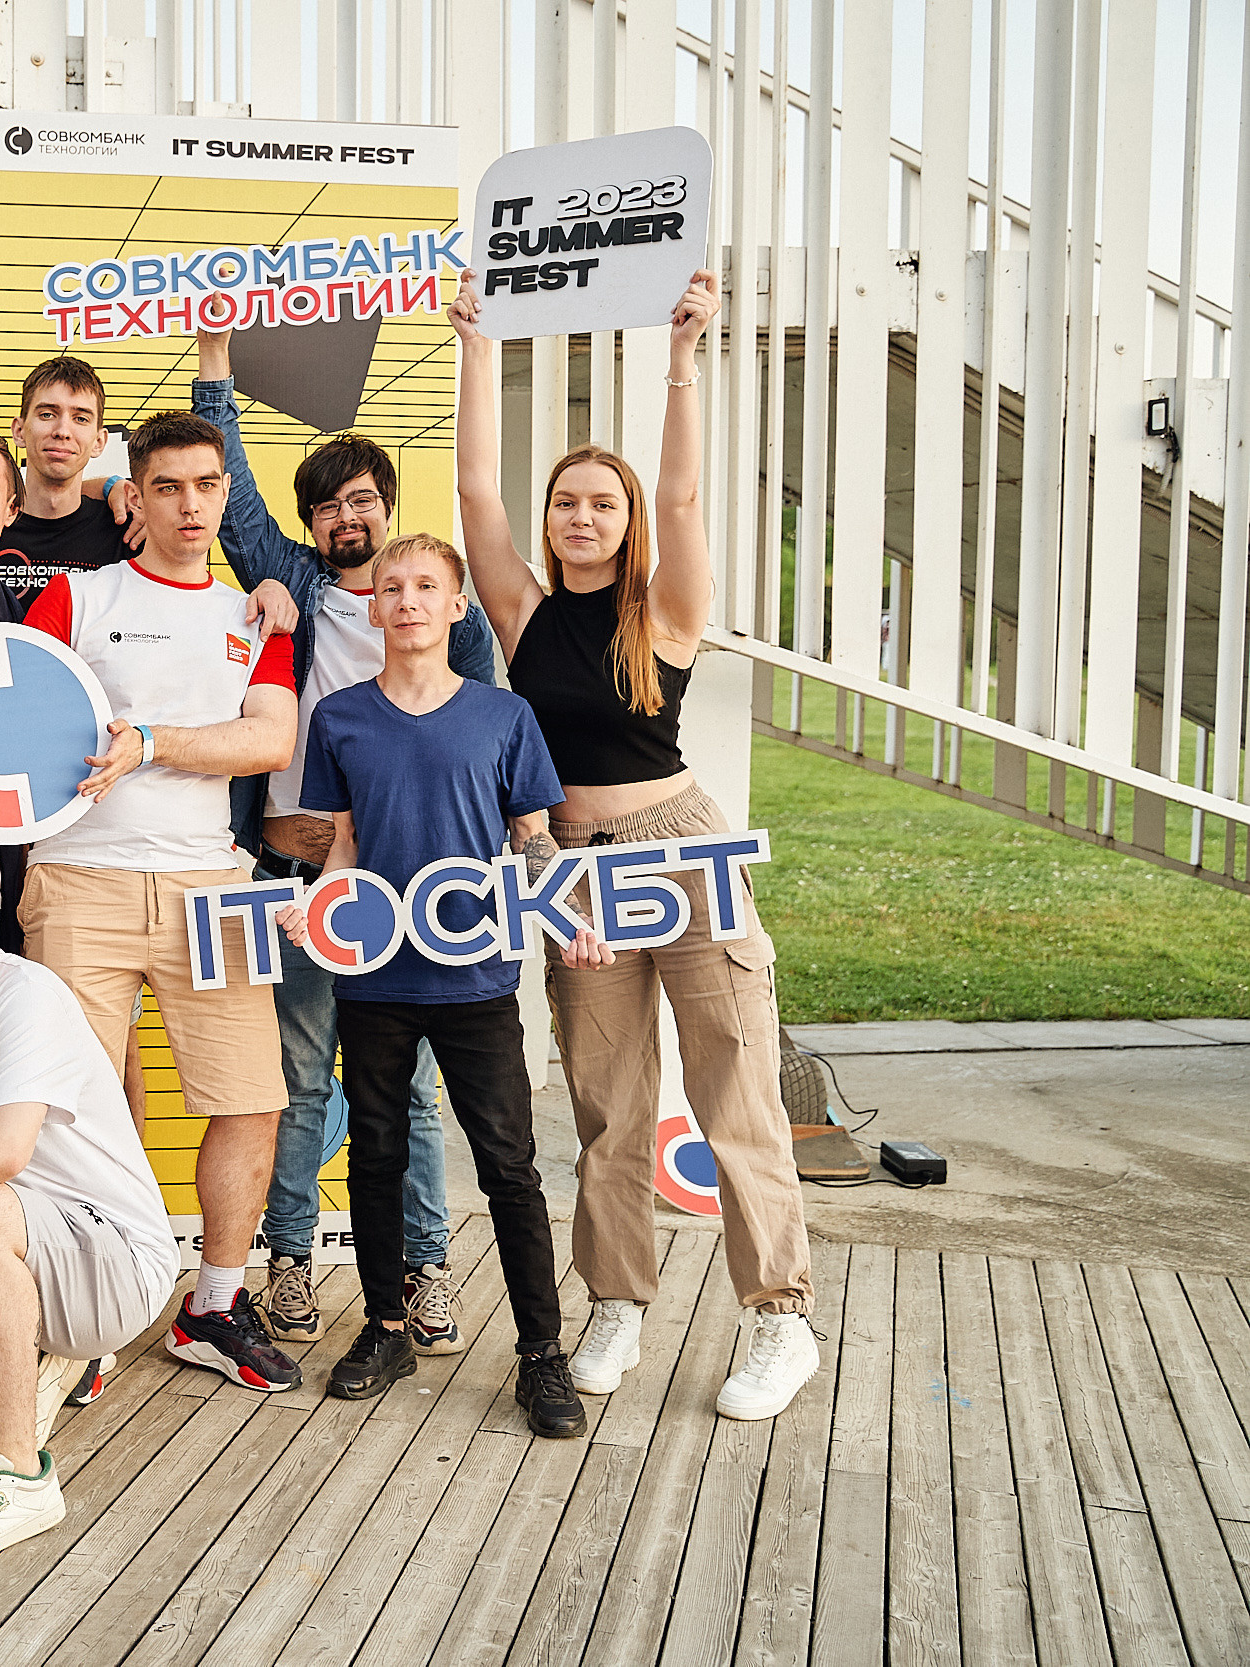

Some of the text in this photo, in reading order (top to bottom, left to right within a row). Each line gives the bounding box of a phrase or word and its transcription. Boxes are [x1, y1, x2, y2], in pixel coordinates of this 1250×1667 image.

[38, 130, 145, 145] СОВКОМБАНК
[38, 144, 118, 156] ТЕХНОЛОГИИ
[172, 138, 415, 165] IT SUMMER FEST
[491, 175, 687, 228] IT 2023
[487, 212, 685, 260] SUMMER
[47, 231, 467, 303] СОВКОМБАНК
[484, 258, 600, 296] FEST
[47, 275, 437, 342] ТЕХНОЛОГИИ
[321, 1231, 354, 1248] FE
